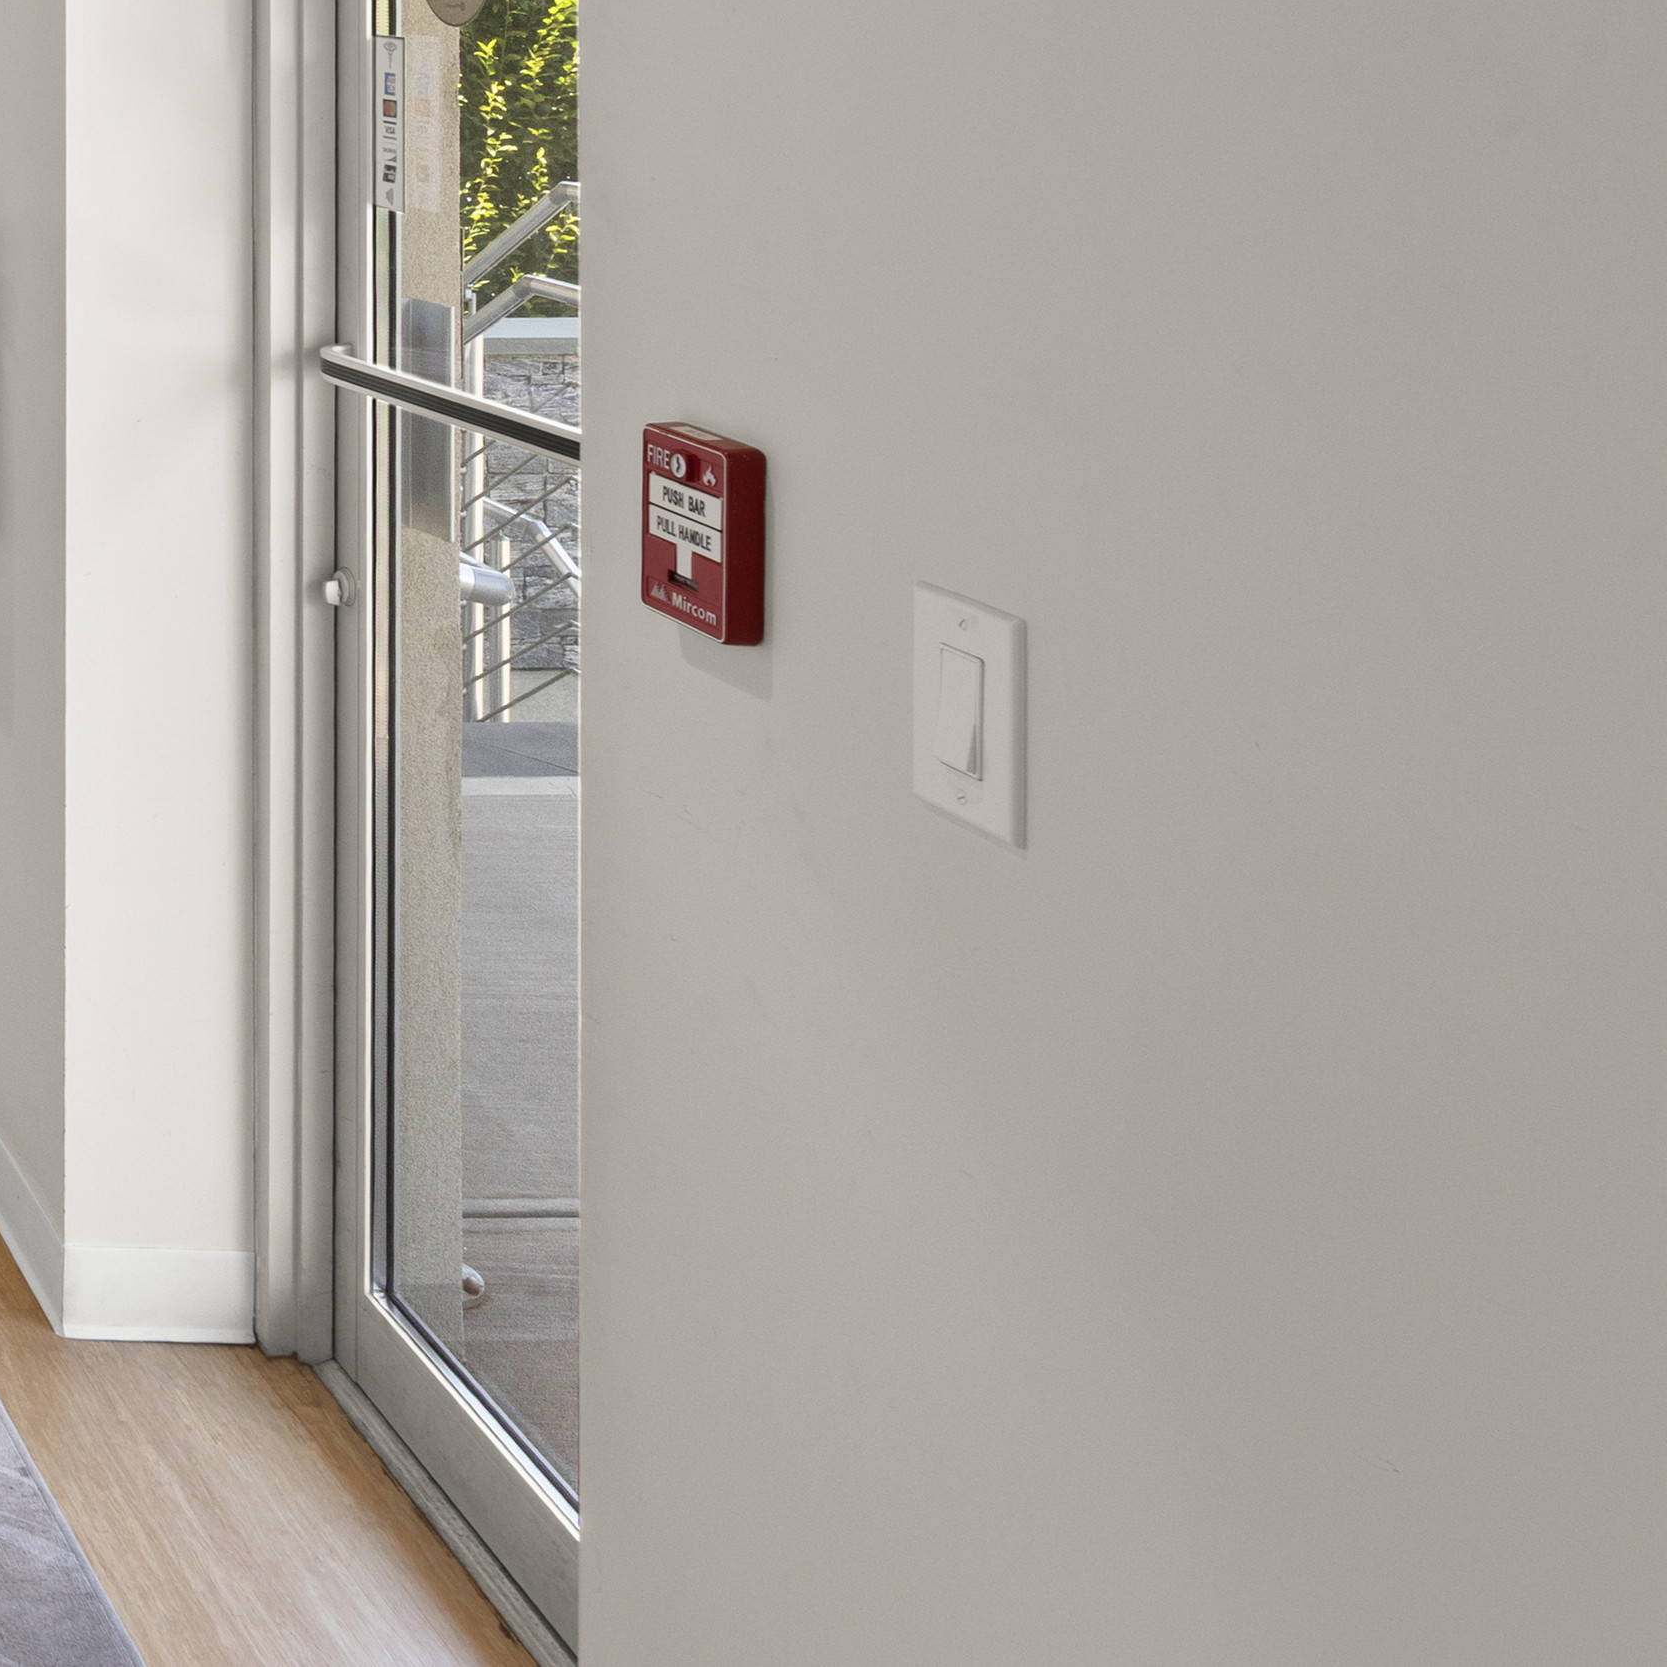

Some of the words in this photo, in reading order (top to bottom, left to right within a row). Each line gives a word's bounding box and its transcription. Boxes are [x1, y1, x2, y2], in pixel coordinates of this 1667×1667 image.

[647, 444, 671, 470] FIRE
[662, 485, 685, 509] PUSH
[688, 495, 707, 518] BAR
[656, 515, 677, 537] PULL
[678, 524, 712, 556] HANDLE
[672, 592, 717, 626] Mircom
